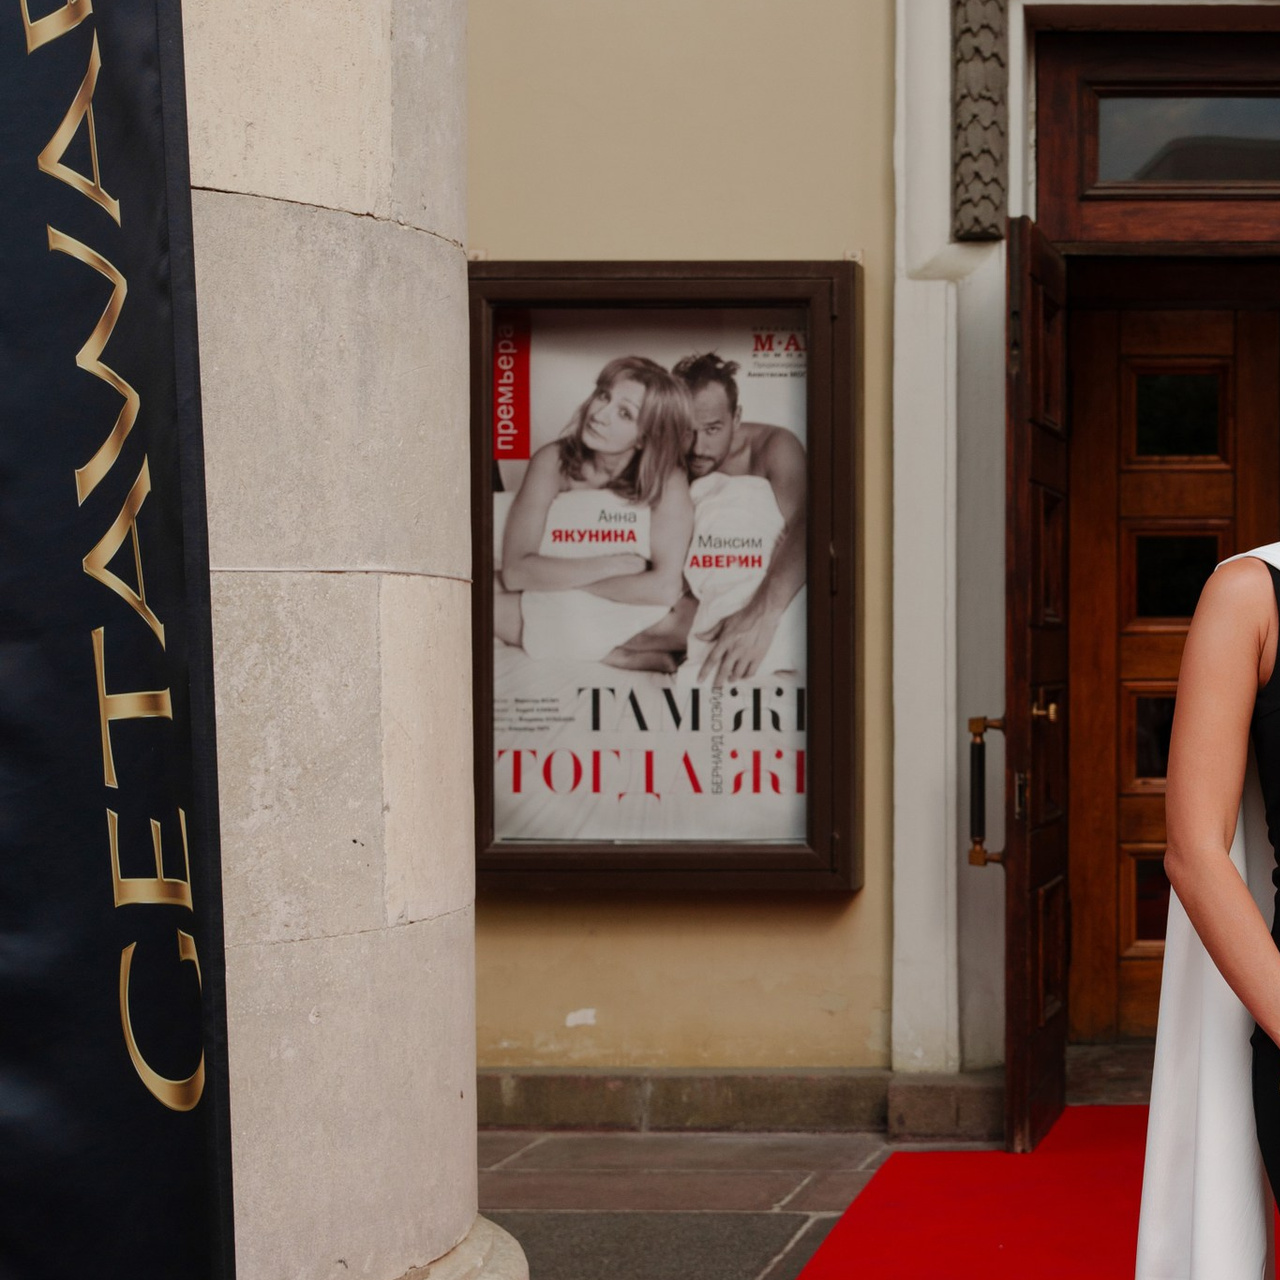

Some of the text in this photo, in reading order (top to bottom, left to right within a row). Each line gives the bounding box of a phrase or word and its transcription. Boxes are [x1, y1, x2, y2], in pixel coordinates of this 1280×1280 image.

[497, 324, 519, 450] премьера
[598, 509, 637, 523] Анна
[552, 529, 637, 543] ЯКУНИНА
[698, 535, 762, 549] Максим
[690, 555, 762, 568] АВЕРИН
[577, 687, 700, 732] ТАМ
[709, 685, 723, 794] БЕРНАРД СЛЭЙД
[498, 749, 704, 802] ТОГДА
